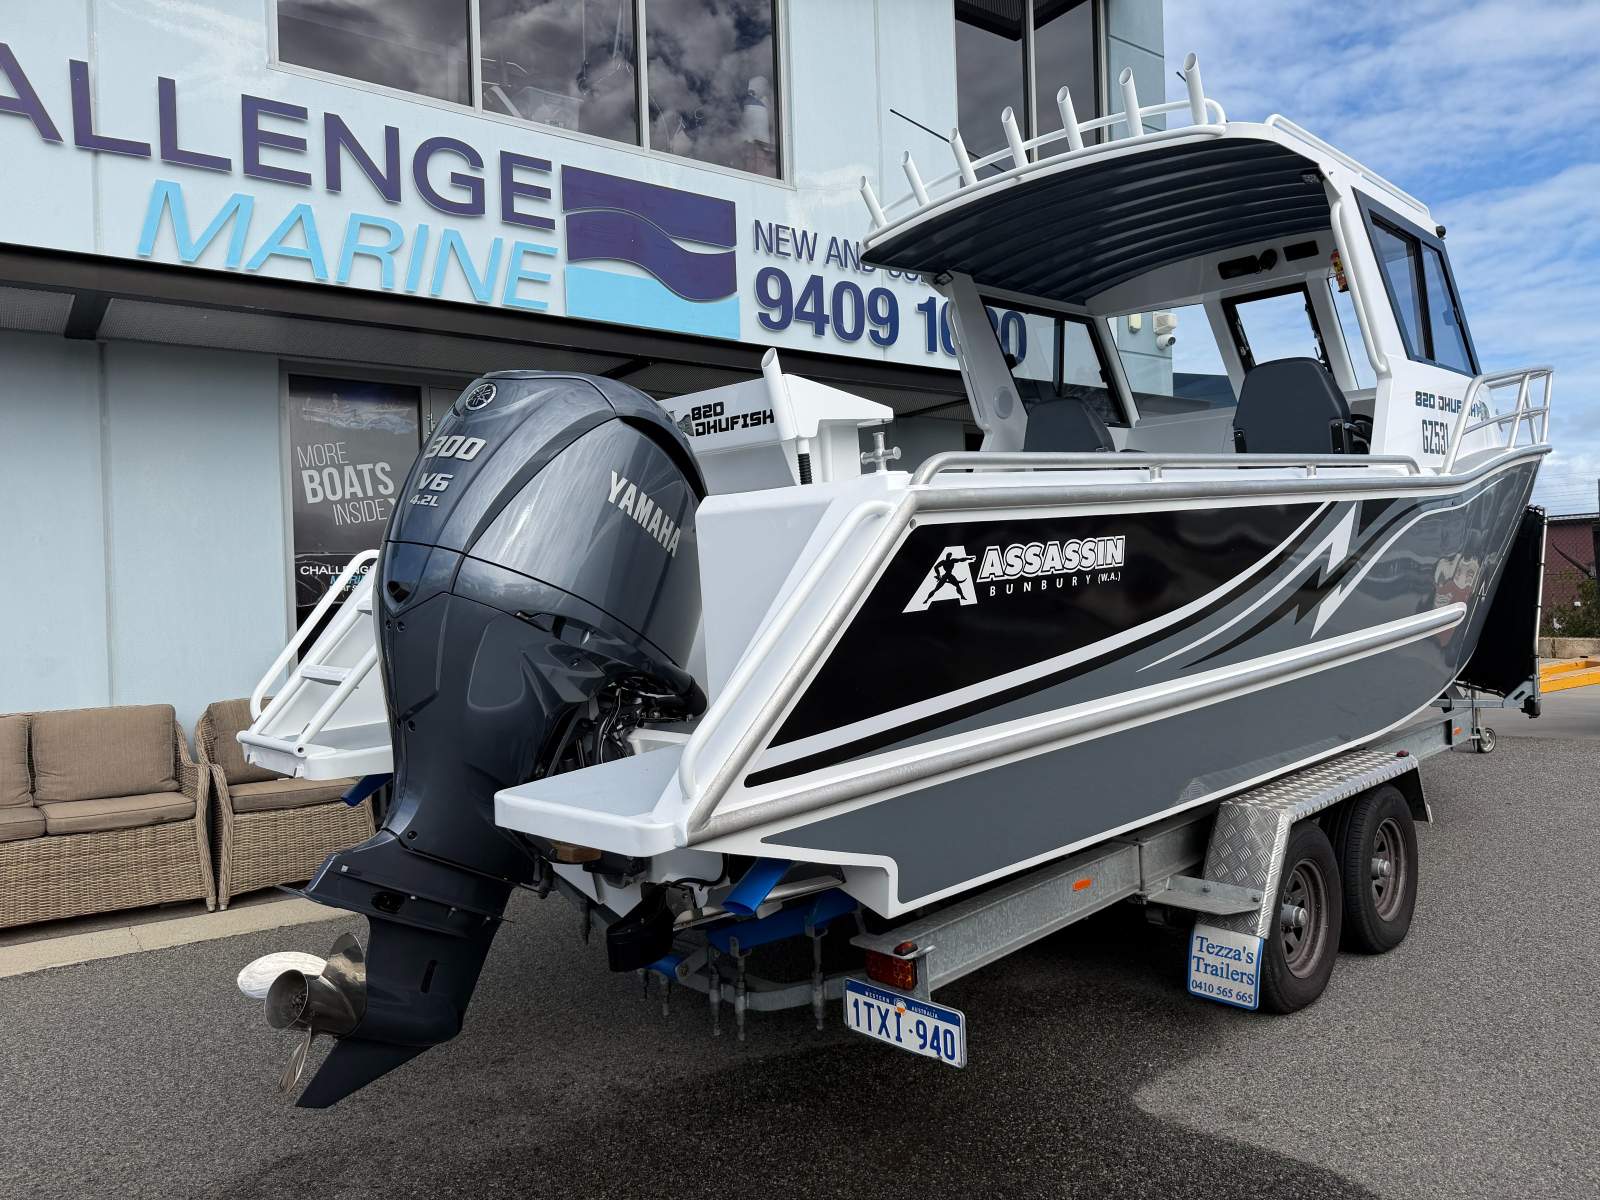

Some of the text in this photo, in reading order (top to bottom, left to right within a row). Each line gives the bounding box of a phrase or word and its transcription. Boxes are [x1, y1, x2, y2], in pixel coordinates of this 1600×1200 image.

[137, 179, 559, 311] MARINE
[754, 219, 818, 262] NEW
[755, 266, 900, 347] 9409
[691, 401, 725, 422] 820
[695, 408, 775, 437] DHUFISH
[296, 441, 350, 468] MORE
[424, 435, 487, 461] 300
[301, 461, 395, 504] BOATS
[418, 473, 455, 492] V6
[332, 498, 388, 526] INSIDE
[409, 494, 440, 507] 4.2L
[607, 469, 681, 558] YAMAHA
[976, 535, 1127, 583] ASSASSIN
[989, 573, 1092, 597] BUNBURY
[1195, 935, 1255, 964] Tezza's
[1192, 955, 1255, 986] Trailers
[1191, 979, 1254, 1004] 0410 565 665
